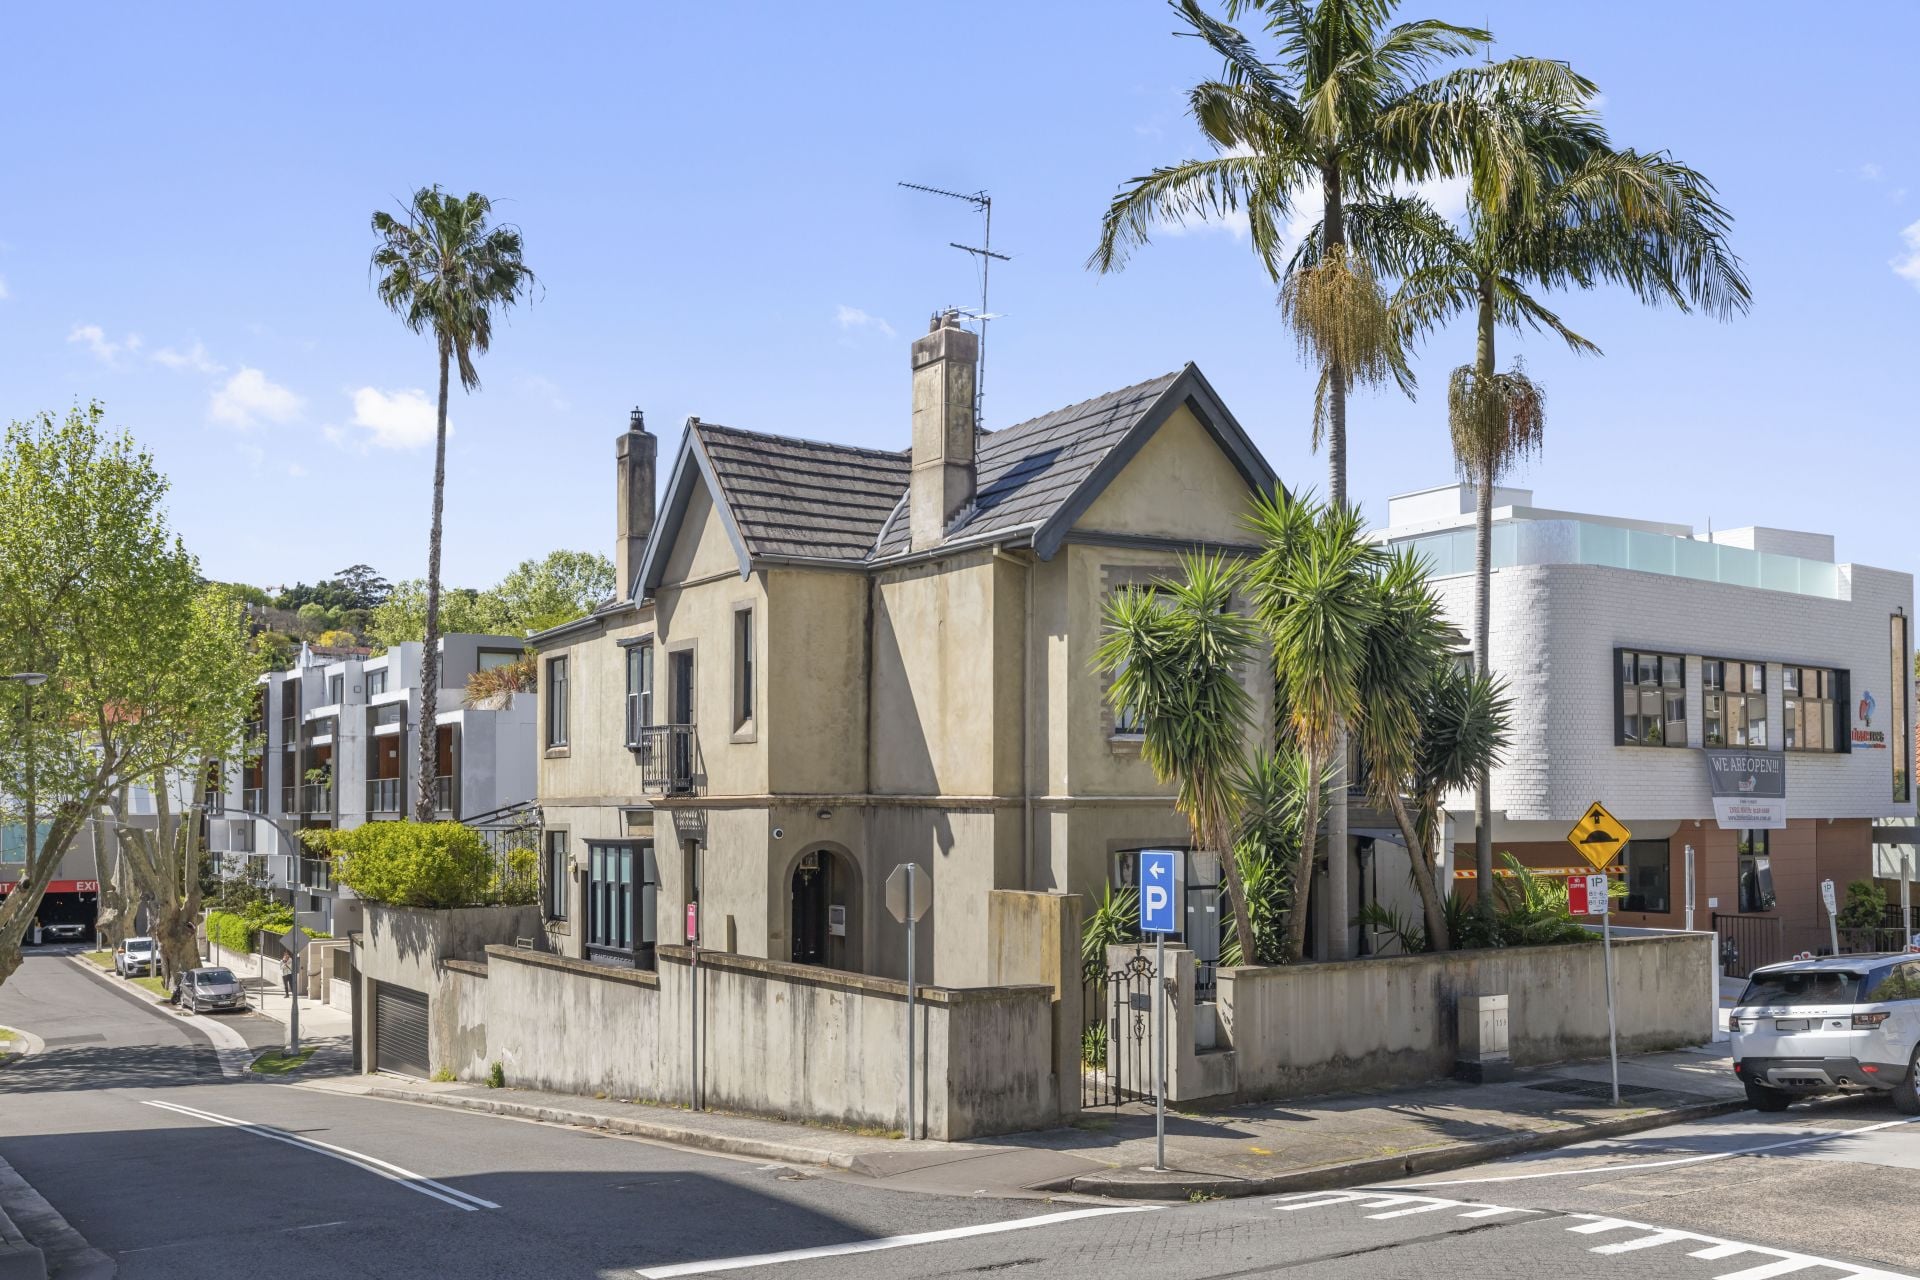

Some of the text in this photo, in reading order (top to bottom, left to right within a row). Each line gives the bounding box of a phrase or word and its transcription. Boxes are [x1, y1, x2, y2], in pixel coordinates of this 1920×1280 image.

[1712, 757, 1779, 773] WE ARE OPEN!!!
[1591, 877, 1603, 887] 1P
[1146, 885, 1168, 921] P
